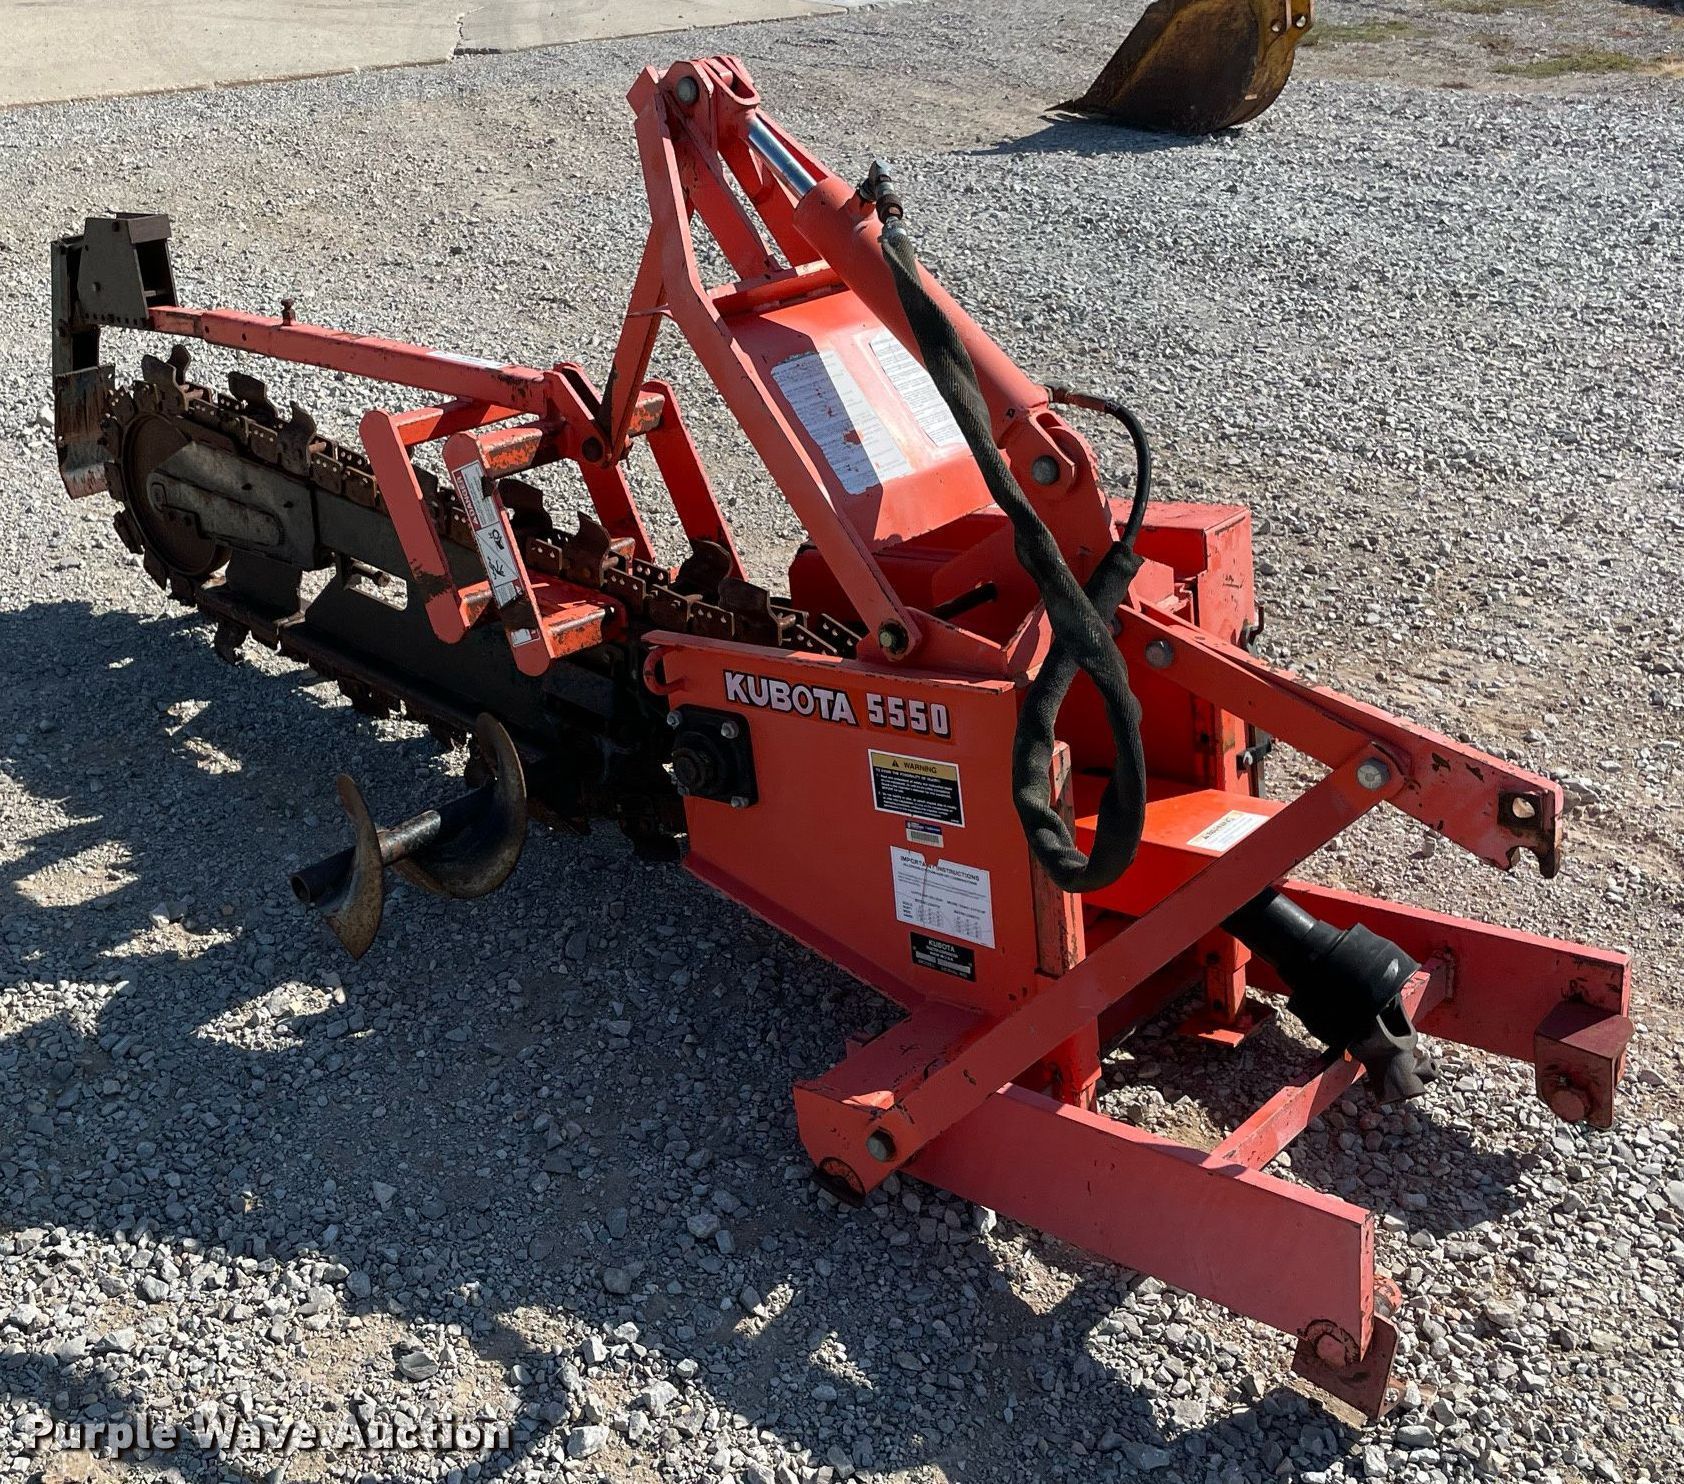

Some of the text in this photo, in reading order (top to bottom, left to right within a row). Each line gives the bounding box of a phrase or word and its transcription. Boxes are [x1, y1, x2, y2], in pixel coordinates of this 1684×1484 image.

[456, 476, 476, 521] DANGER
[723, 669, 951, 737] KUBOTA 5550
[904, 762, 937, 774] WARNING
[937, 865, 980, 882] INSTRUCTIONS
[928, 939, 955, 952] KUBOTA
